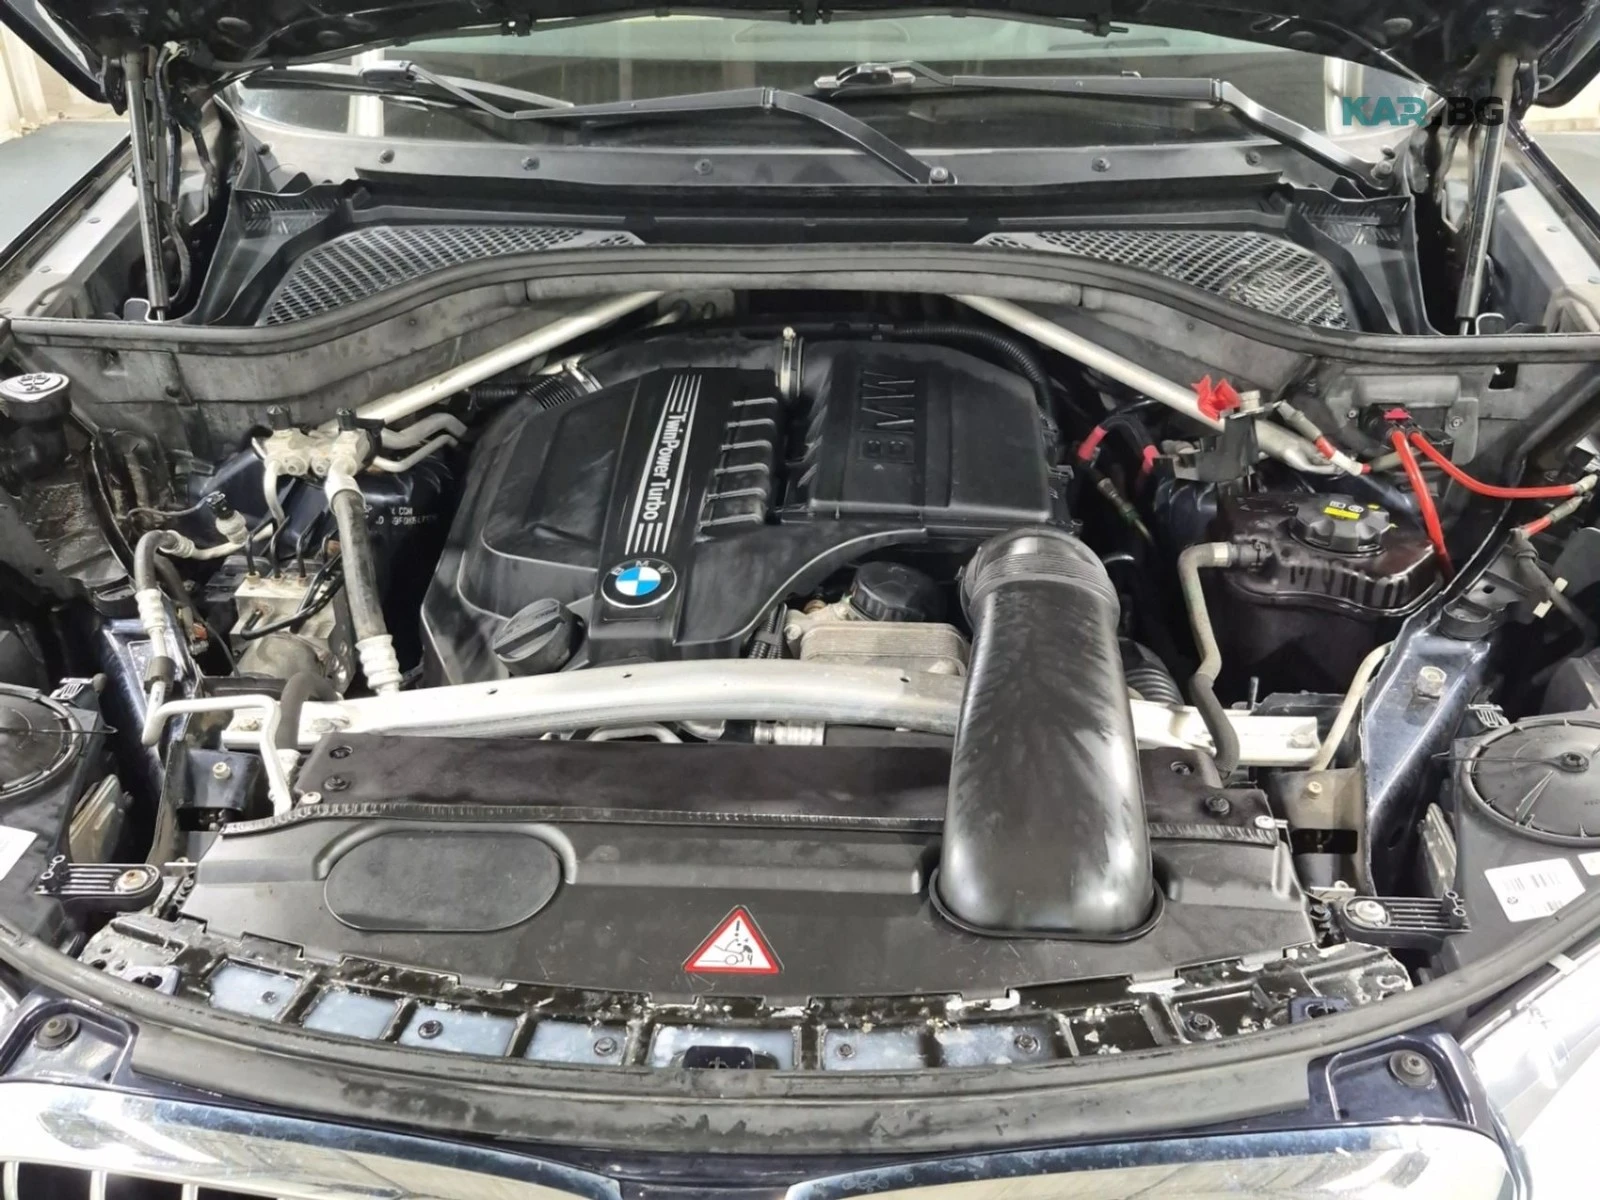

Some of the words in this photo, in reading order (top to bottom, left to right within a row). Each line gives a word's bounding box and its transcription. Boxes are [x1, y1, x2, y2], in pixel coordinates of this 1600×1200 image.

[855, 369, 916, 464] BMW
[653, 412, 687, 478] TwinPower
[643, 479, 671, 520] Turbo
[610, 560, 671, 576] BMW
